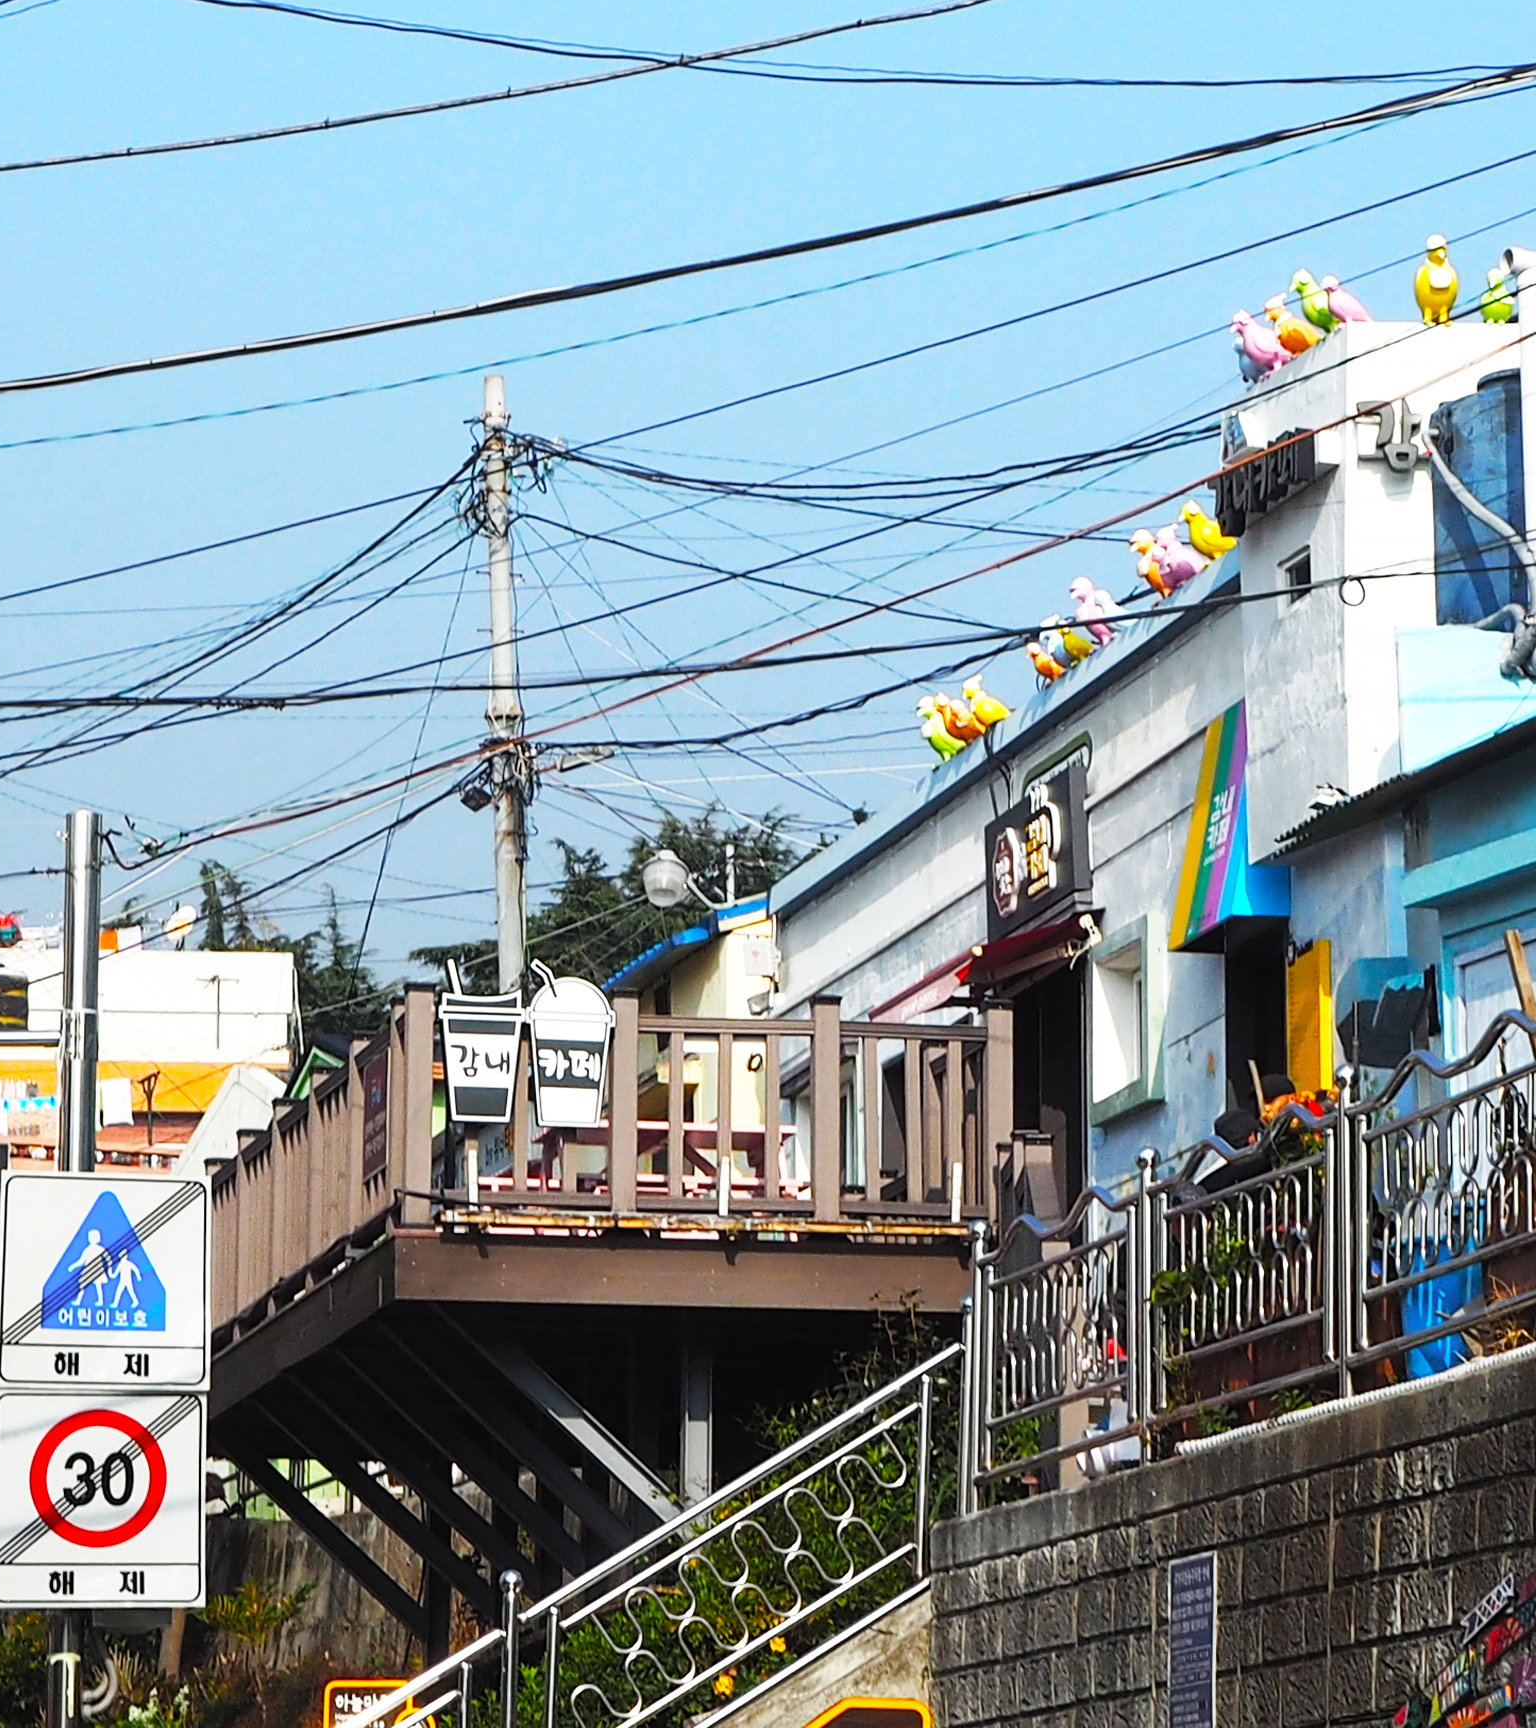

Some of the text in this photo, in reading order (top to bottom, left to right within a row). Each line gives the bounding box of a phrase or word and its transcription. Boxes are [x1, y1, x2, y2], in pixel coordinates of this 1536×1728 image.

[451, 1044, 601, 1082] 감내 카페
[58, 1308, 149, 1328] 어린이보호
[62, 1452, 135, 1507] 30
[335, 1692, 387, 1713] 하늘마
